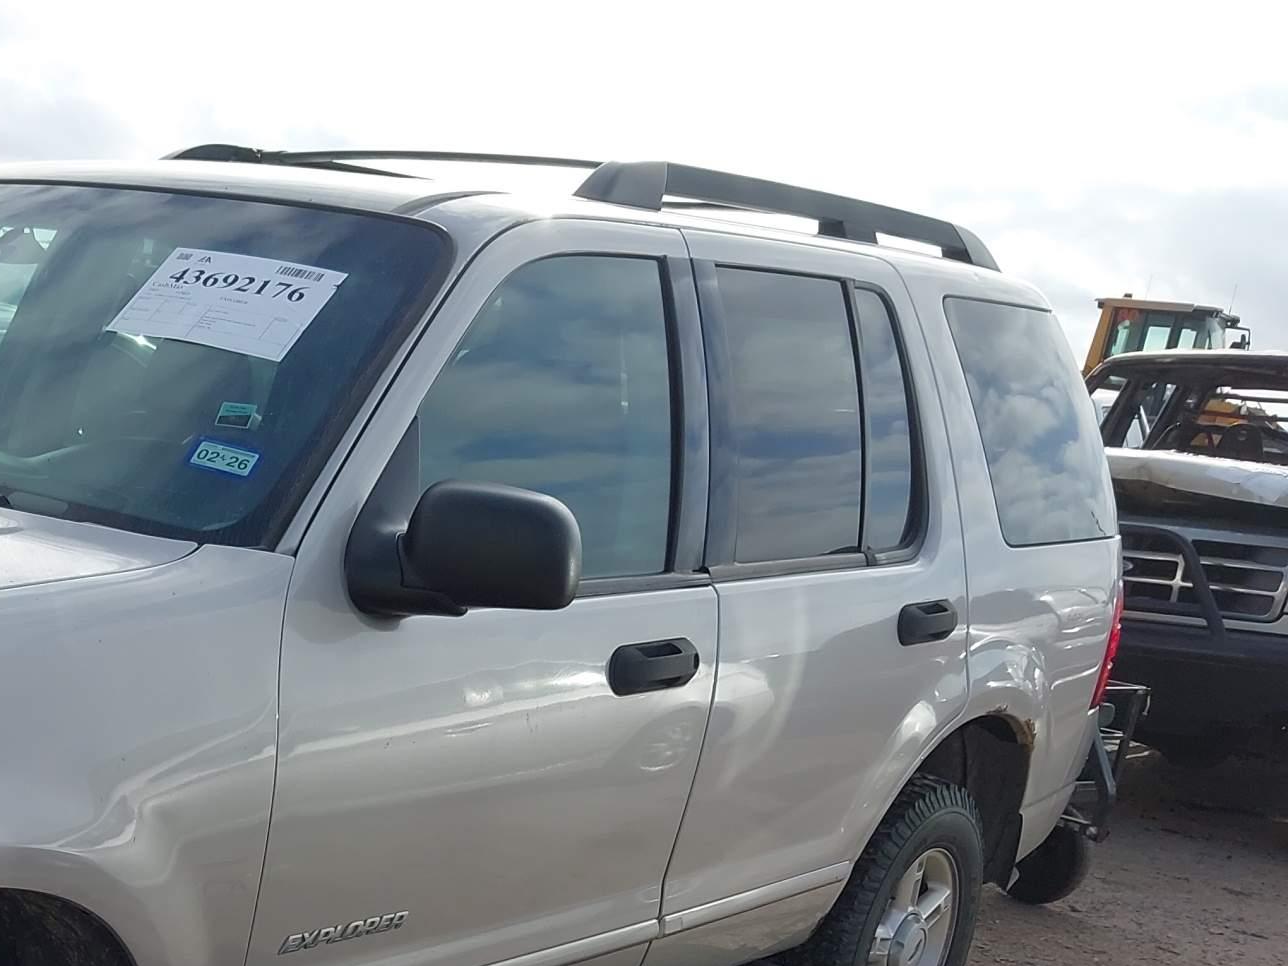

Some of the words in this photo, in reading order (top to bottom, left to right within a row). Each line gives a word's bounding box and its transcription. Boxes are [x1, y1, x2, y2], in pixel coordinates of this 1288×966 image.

[168, 266, 311, 303] 43692176
[196, 448, 220, 464] 02
[225, 456, 250, 471] 26
[277, 911, 409, 955] EXPLORER
